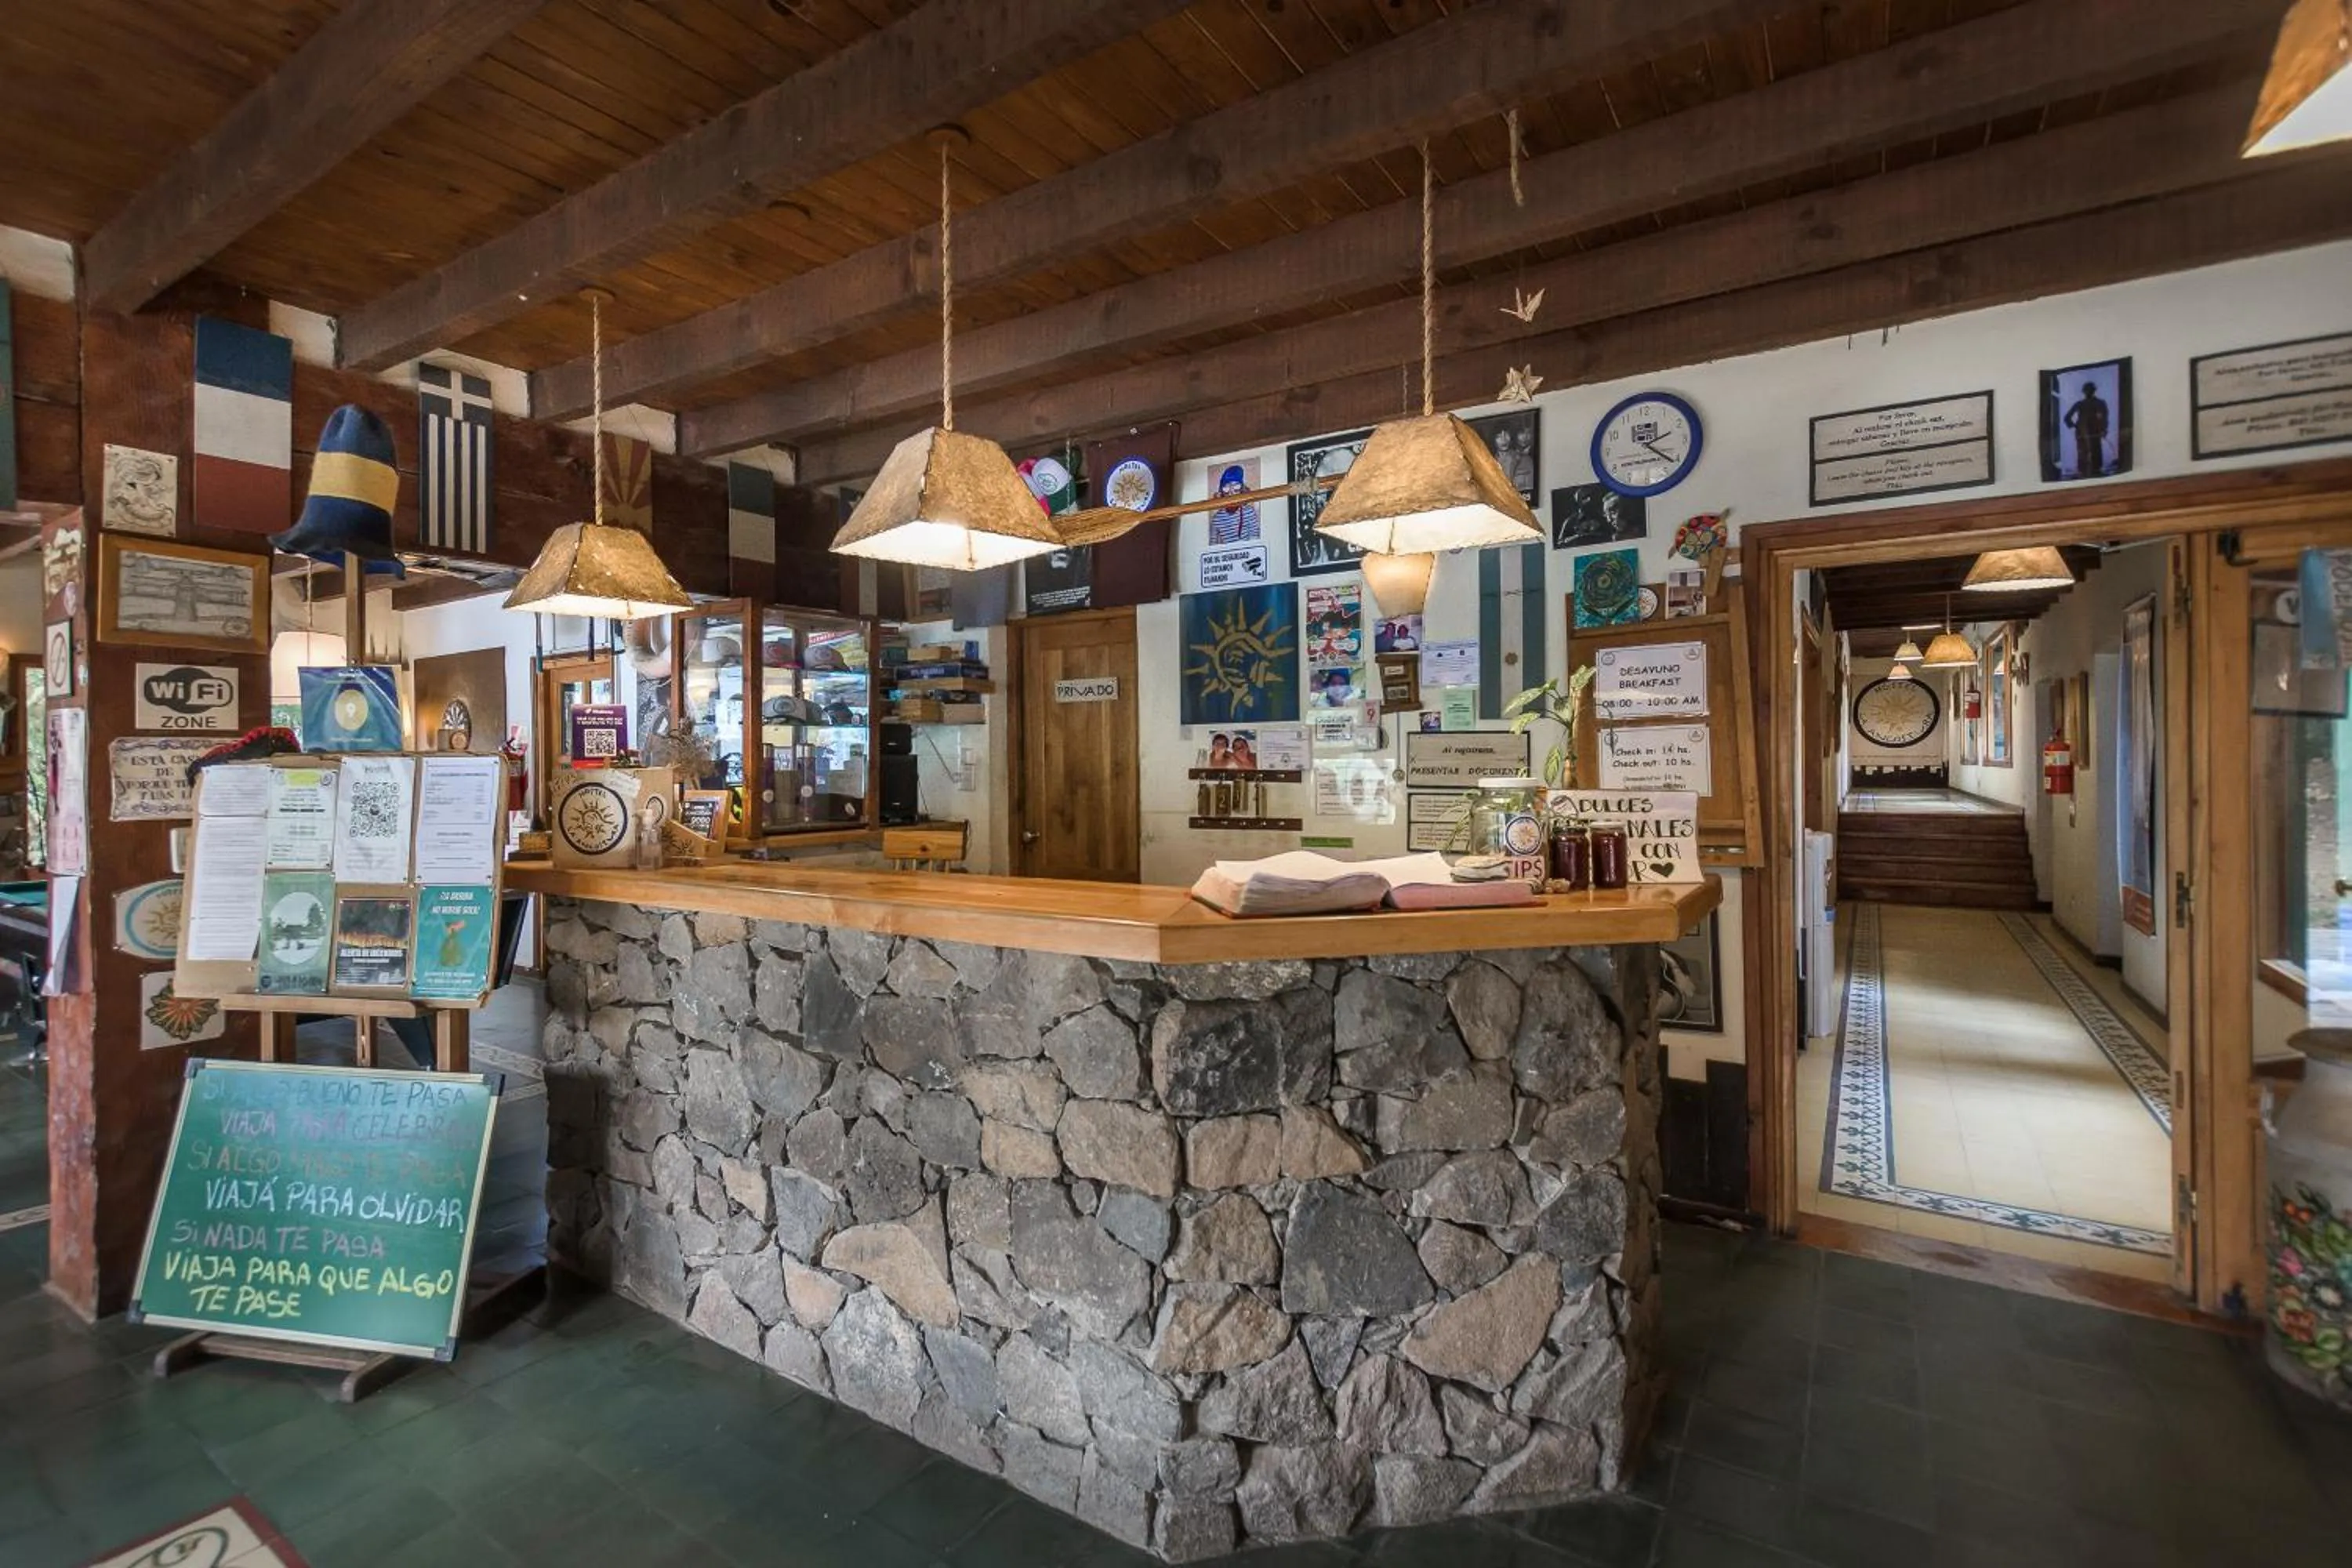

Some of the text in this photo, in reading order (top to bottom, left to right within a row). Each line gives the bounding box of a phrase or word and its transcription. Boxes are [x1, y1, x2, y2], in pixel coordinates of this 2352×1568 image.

[1620, 664, 1680, 676] DESAYUNO
[1619, 677, 1682, 688] BREAKFAST
[1057, 684, 1114, 697] PRIVADO
[161, 716, 218, 728] ZONE
[1367, 709, 1374, 720] 9
[1411, 767, 1460, 775] PRESENTAR
[1579, 798, 1653, 813] DULCES
[1641, 843, 1681, 859] CON
[370, 1081, 397, 1106] TE
[406, 1081, 468, 1108] PASA
[220, 1110, 276, 1135] VIAJA
[286, 1181, 353, 1217] PARA
[204, 1224, 267, 1250] NADA
[276, 1225, 310, 1252] TE
[321, 1229, 385, 1258] PASA
[247, 1257, 312, 1286] PARA
[318, 1265, 371, 1296] QUE
[378, 1267, 454, 1298] ALGO
[190, 1285, 302, 1318] TE PASE
